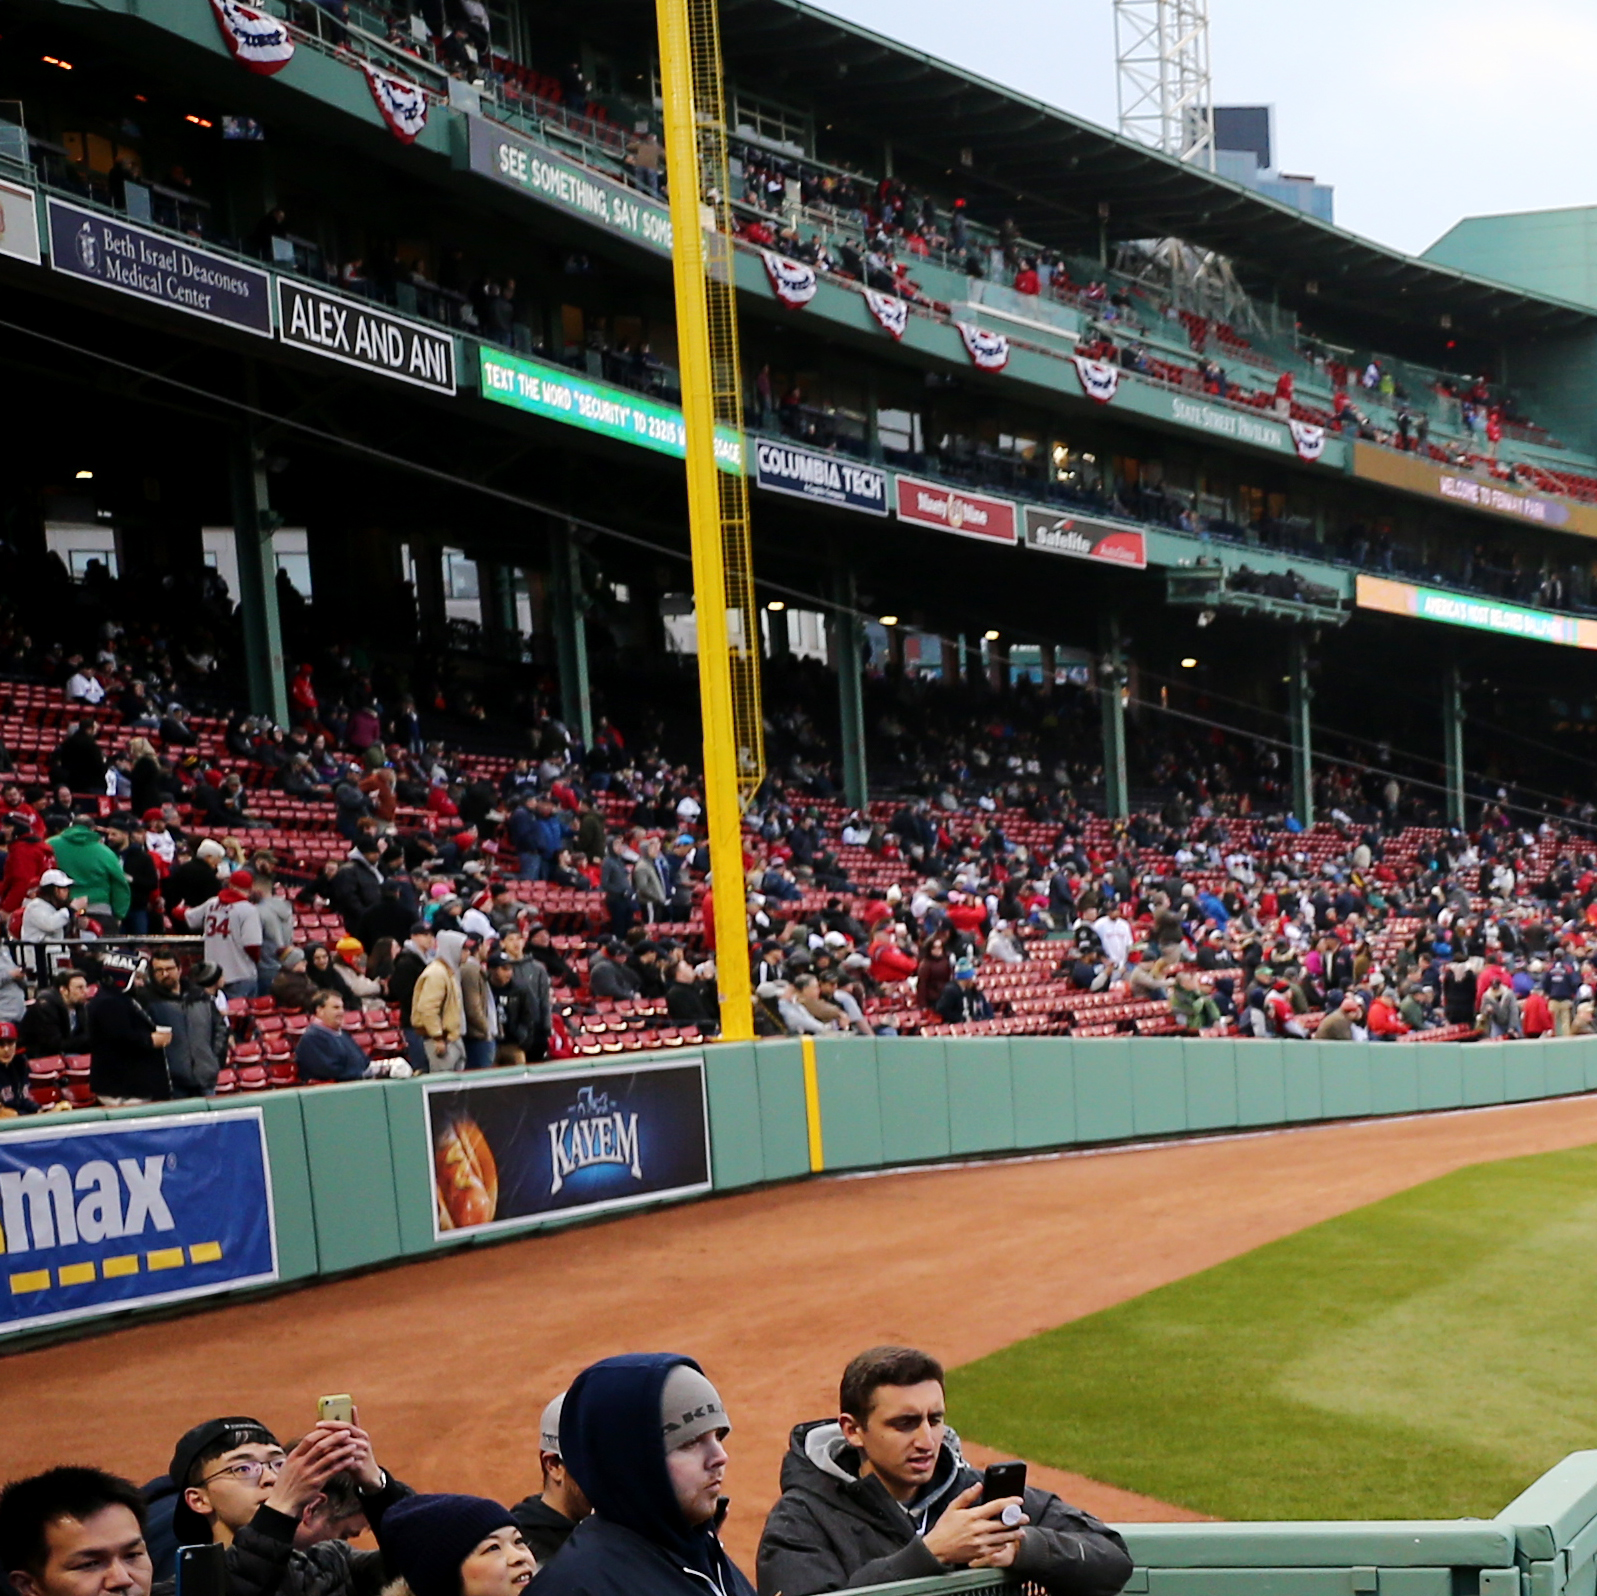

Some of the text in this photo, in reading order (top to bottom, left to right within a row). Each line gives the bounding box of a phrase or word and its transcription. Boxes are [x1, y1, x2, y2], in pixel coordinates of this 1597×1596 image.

[499, 143, 528, 182] SEE
[531, 158, 610, 224] SOMETHING,
[612, 197, 639, 232] SAY
[103, 228, 249, 297] Beth Israel Deaconess
[106, 257, 212, 310] Medical Center
[291, 294, 447, 384] ALEX AND ANI
[484, 362, 515, 392] TEXT
[517, 374, 541, 401] THE
[542, 382, 571, 410] WORD
[633, 411, 646, 433] TO
[759, 445, 841, 490] COLUMBIA
[842, 467, 881, 500] TECH
[1036, 525, 1091, 553] Safelite
[206, 915, 230, 939] 34
[548, 1112, 642, 1196] KAYEM
[0, 1154, 175, 1254] max
